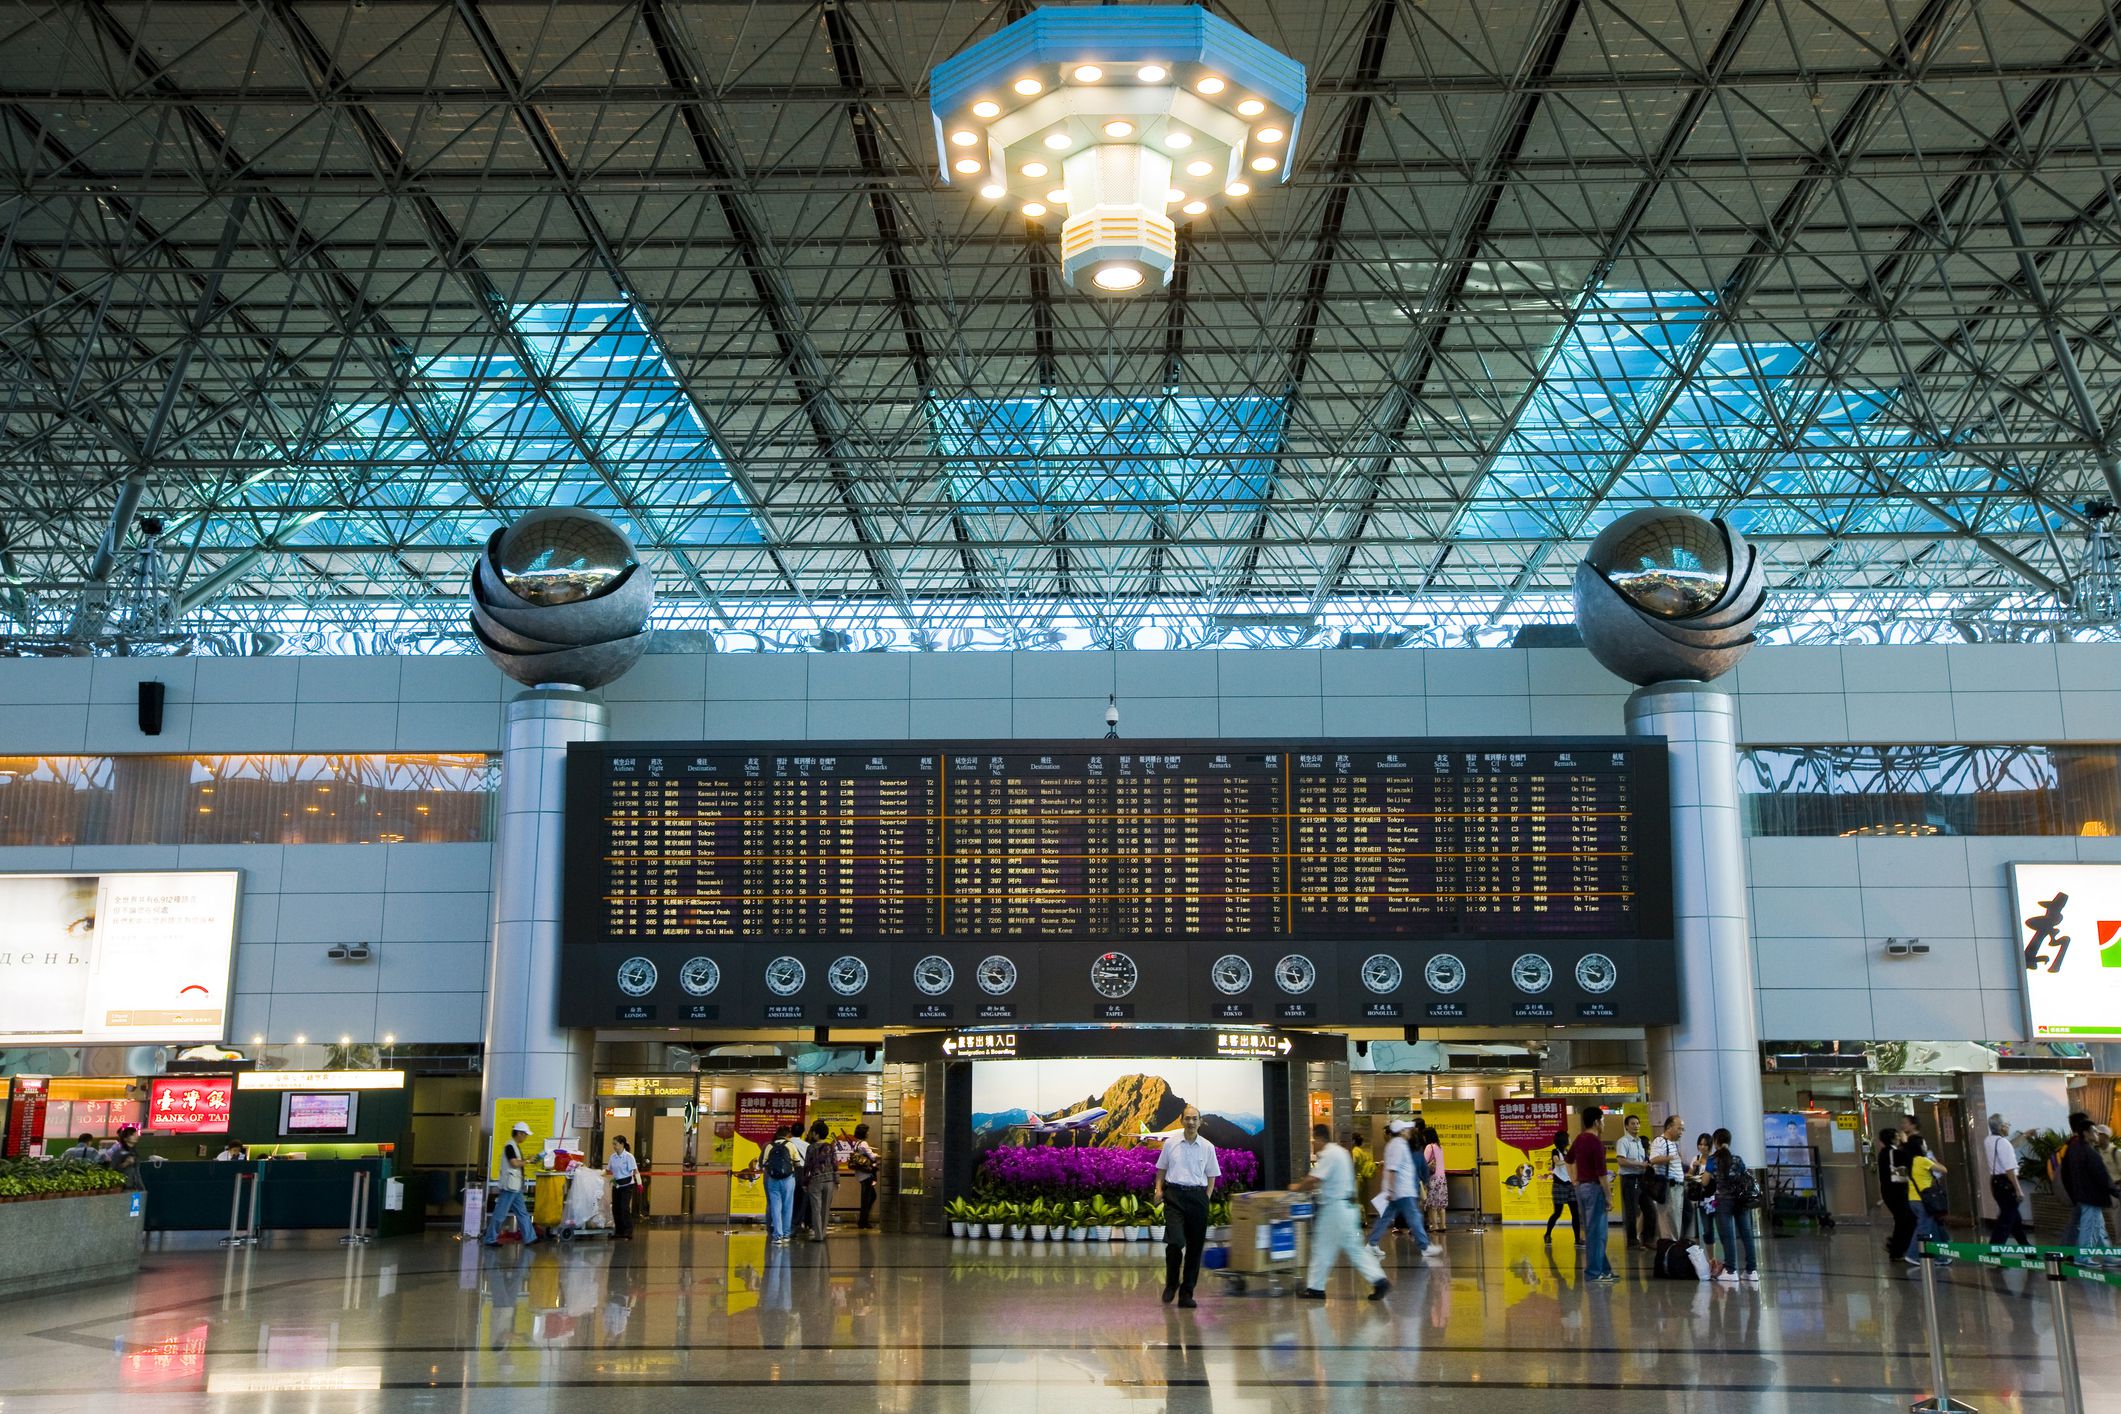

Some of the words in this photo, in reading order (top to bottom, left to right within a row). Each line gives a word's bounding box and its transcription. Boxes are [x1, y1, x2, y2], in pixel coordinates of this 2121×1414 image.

[958, 1035, 1015, 1048] 旅客出境入口
[1218, 1034, 1276, 1047] 旅客出境入口
[155, 1114, 185, 1122] BANK
[189, 1114, 204, 1122] OF
